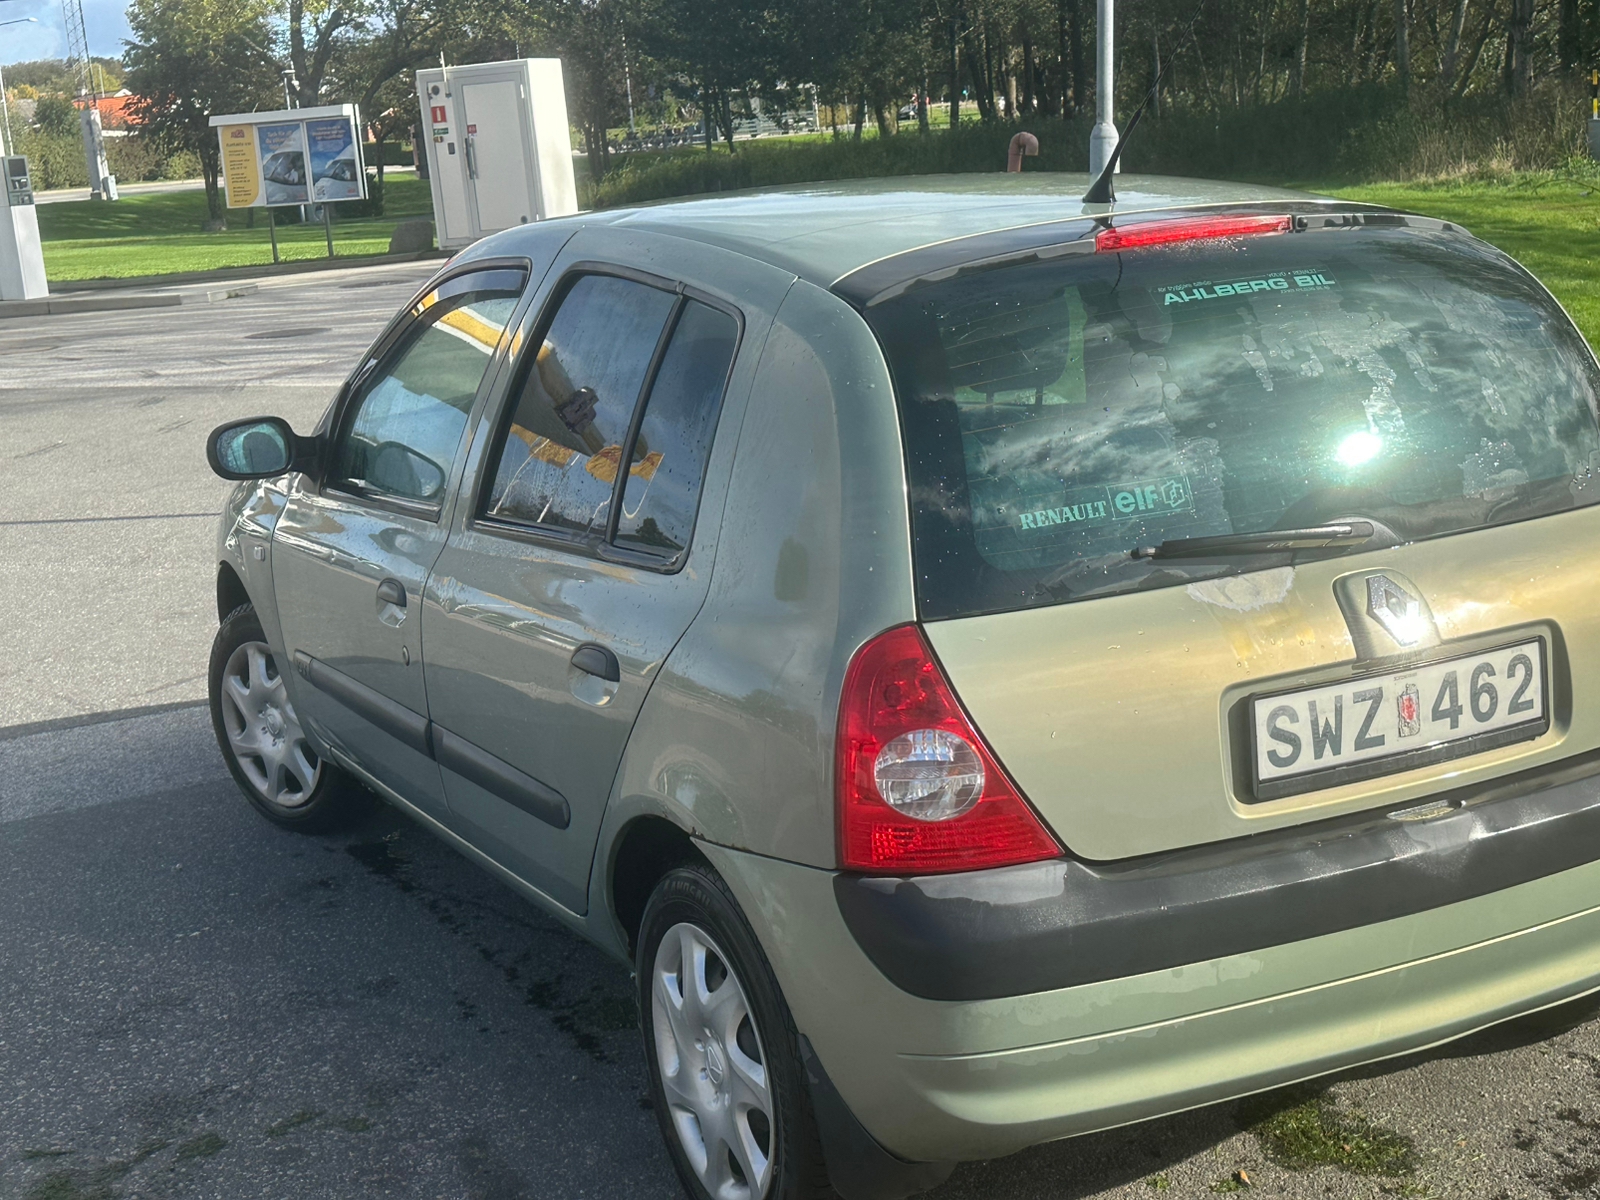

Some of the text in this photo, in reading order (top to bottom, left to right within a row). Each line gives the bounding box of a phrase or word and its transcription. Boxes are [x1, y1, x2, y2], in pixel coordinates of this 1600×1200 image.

[1164, 273, 1336, 306] AHLBERG BIL
[1018, 484, 1159, 531] RENAULT elf
[1266, 653, 1535, 769] SWZ 462
